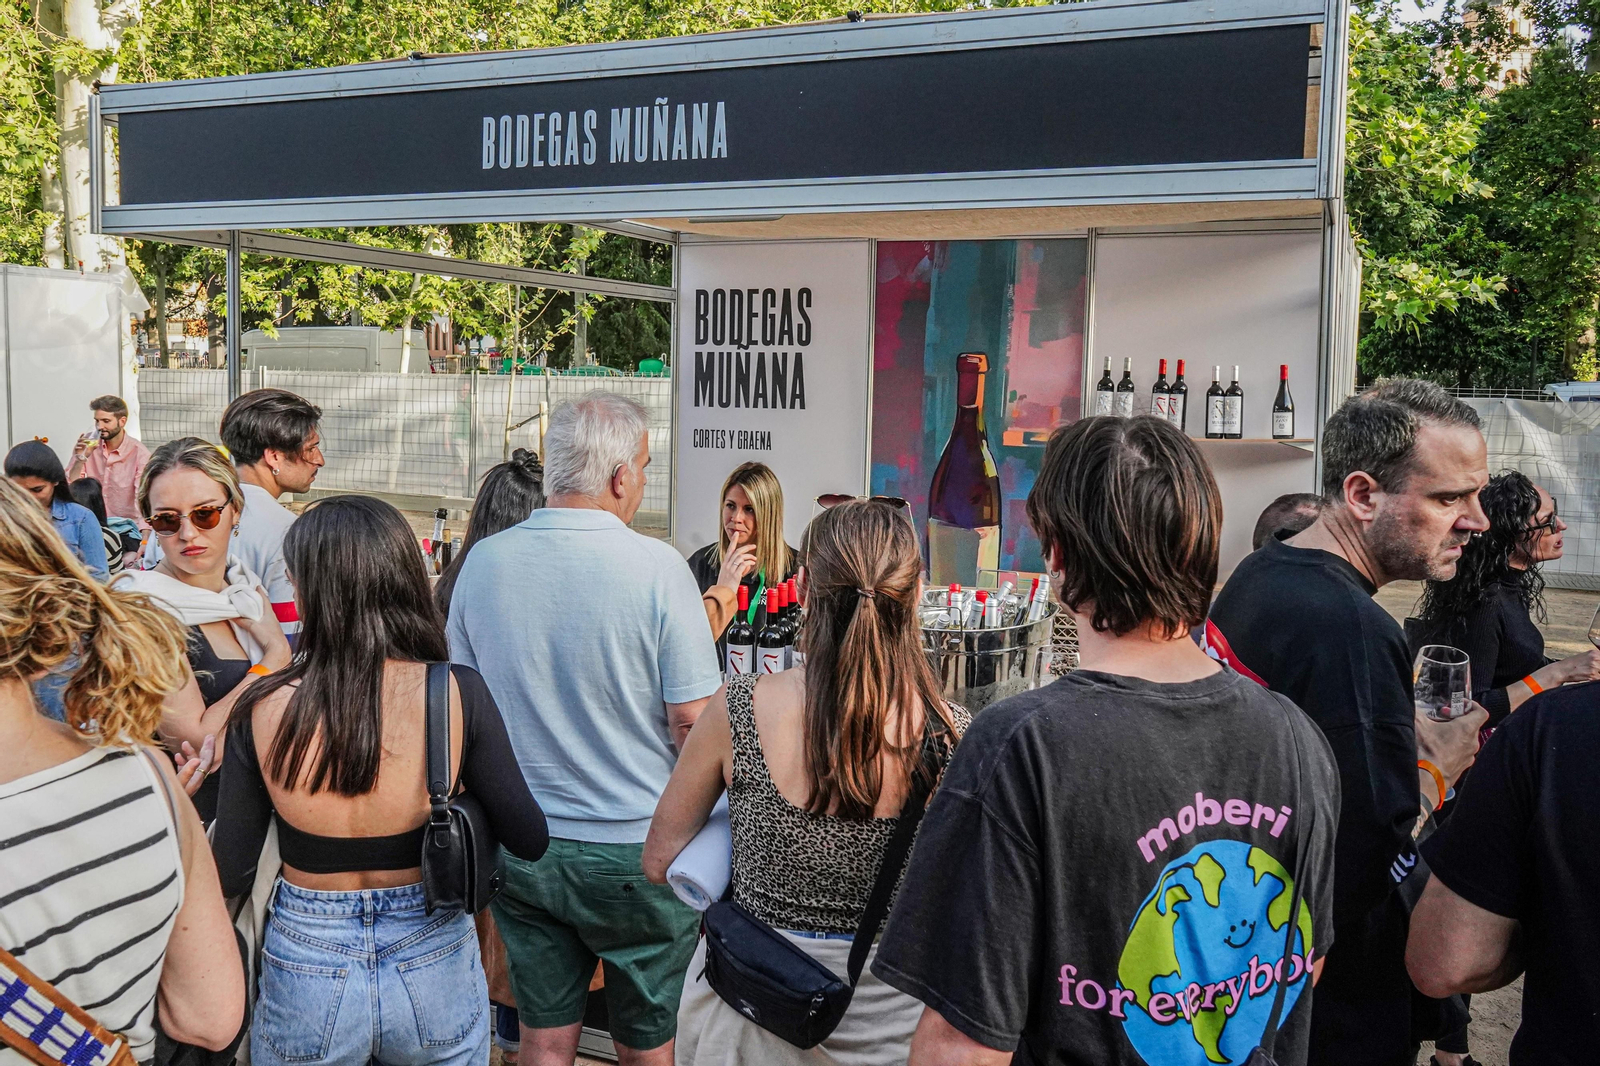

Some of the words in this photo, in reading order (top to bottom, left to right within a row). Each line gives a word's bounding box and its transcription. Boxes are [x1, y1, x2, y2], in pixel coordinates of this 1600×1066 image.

[482, 109, 597, 170] BODEGAS
[609, 97, 728, 164] MUÑANA
[694, 287, 812, 347] BODEGAS
[694, 343, 806, 410] MUÑANA
[693, 428, 726, 449] CORTES
[728, 430, 735, 449] Y
[737, 430, 772, 451] GRAENA
[1136, 792, 1293, 863] moberi
[1057, 964, 1137, 1018] for
